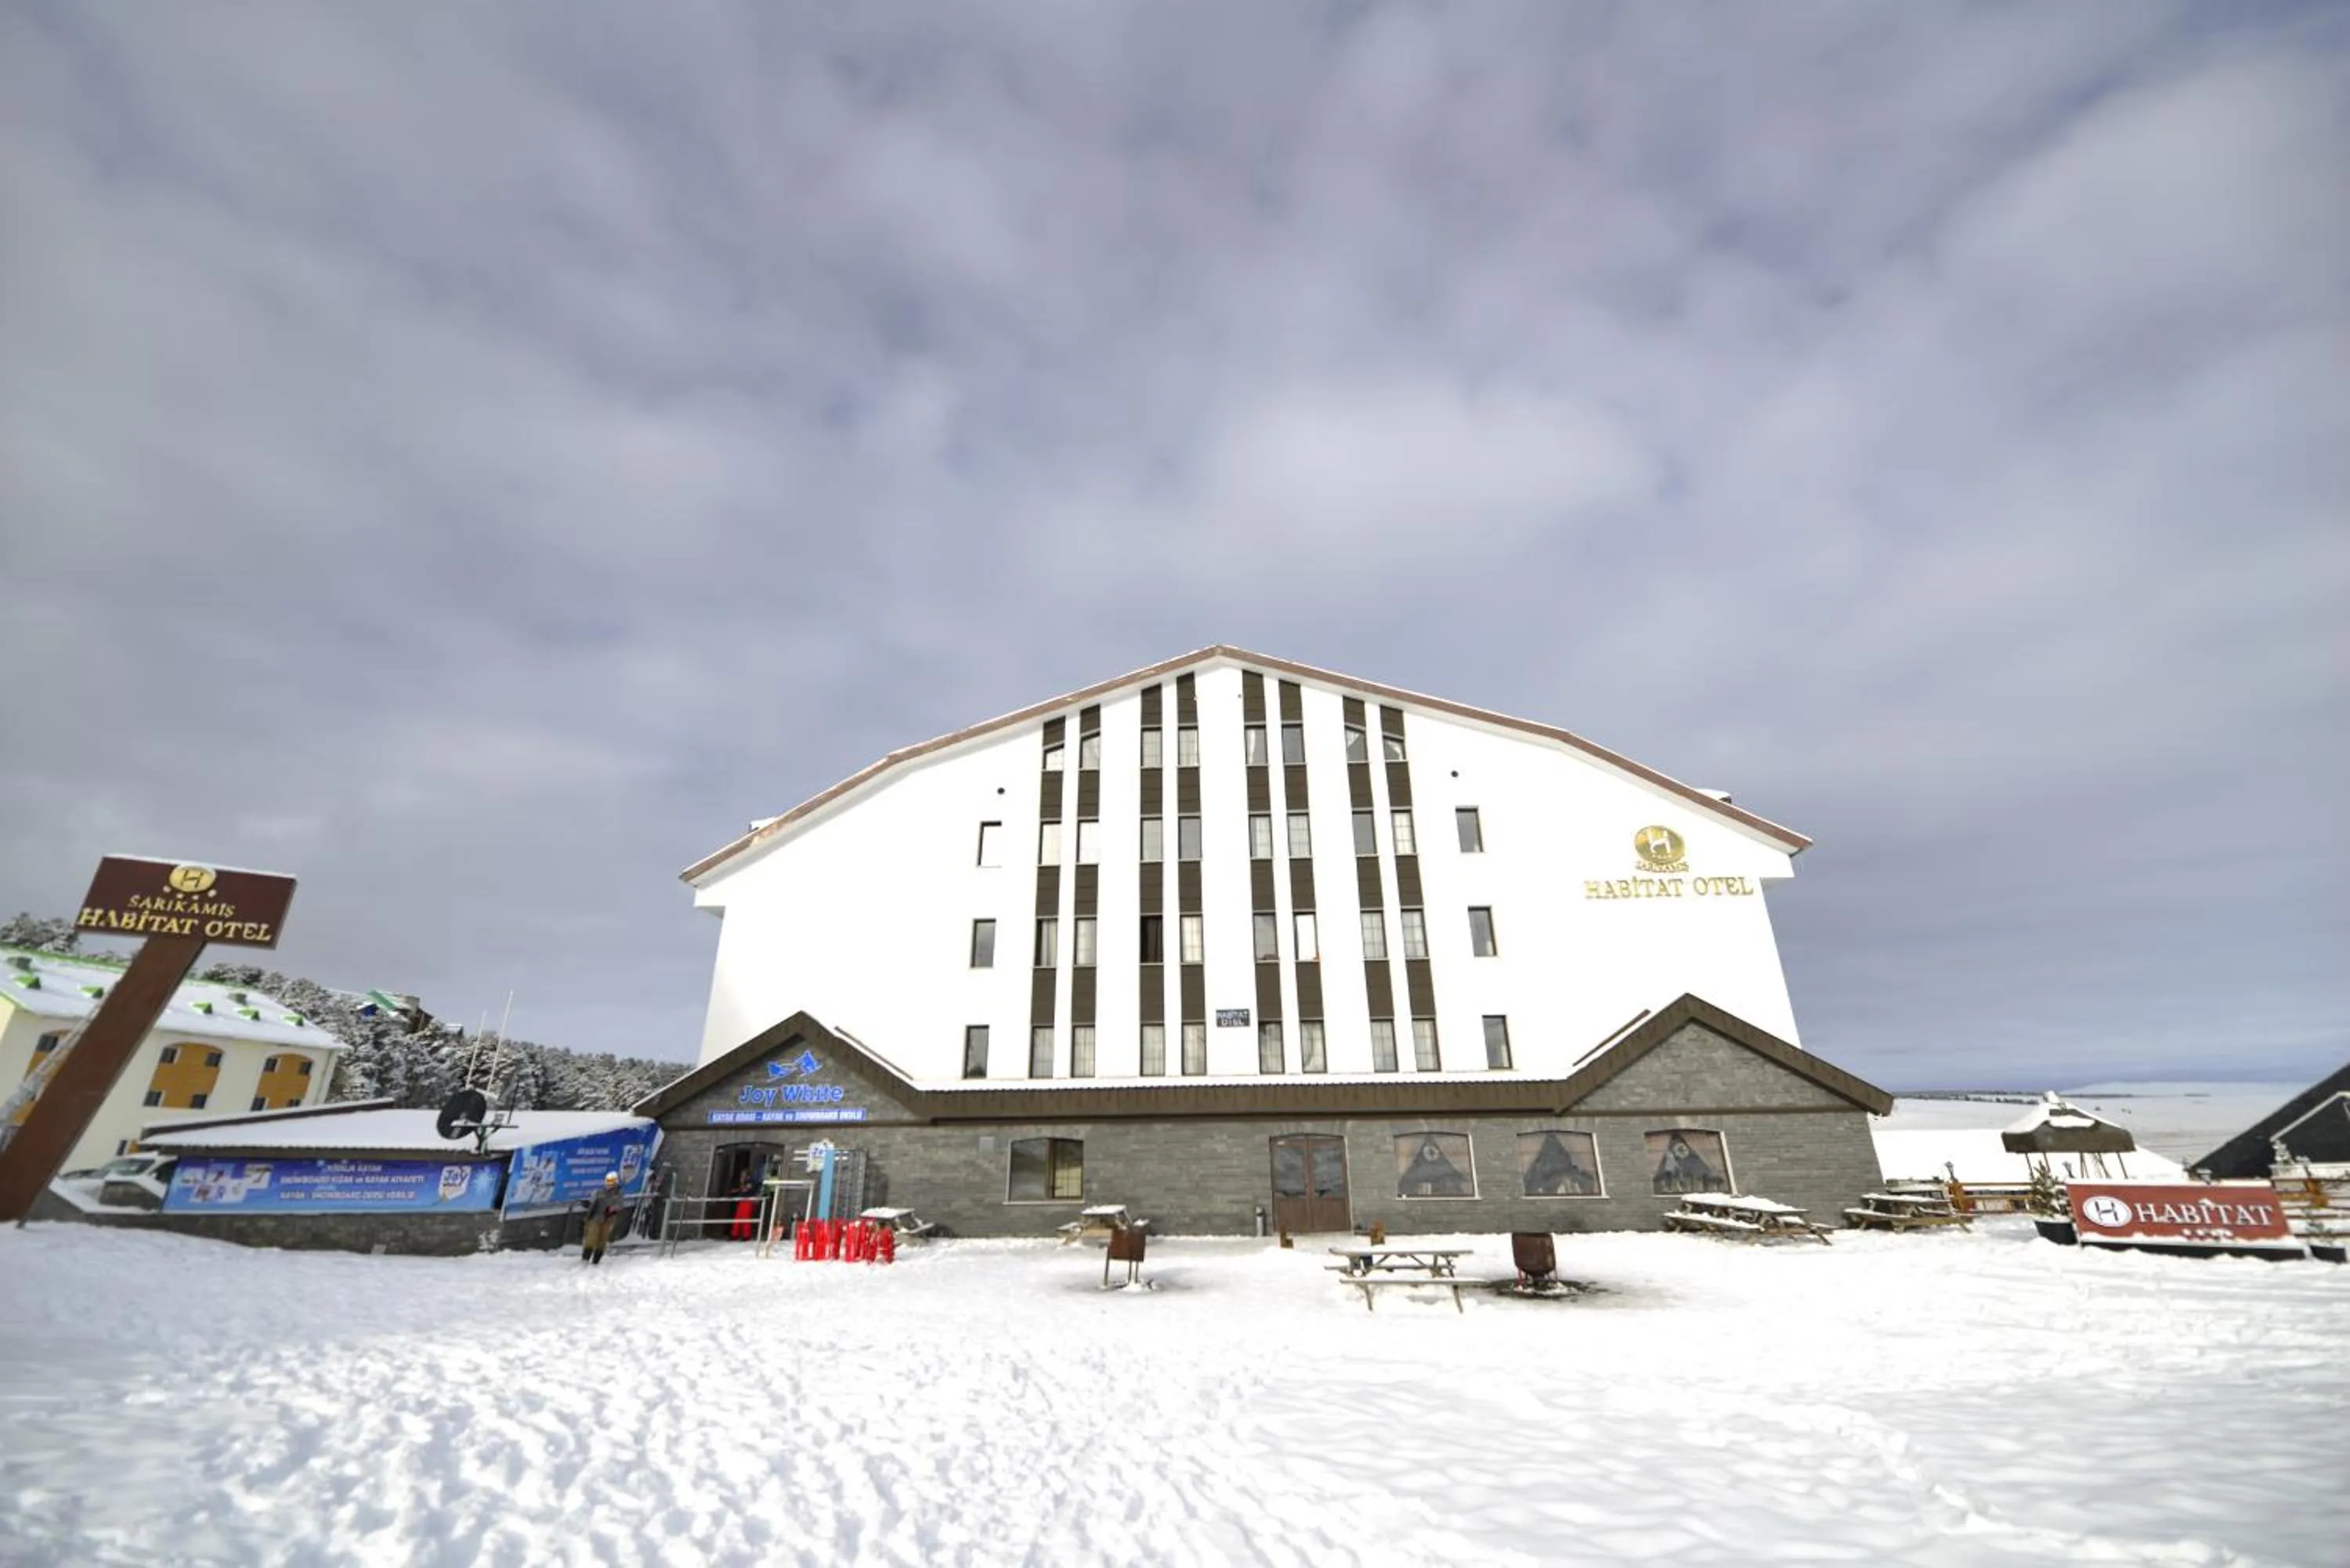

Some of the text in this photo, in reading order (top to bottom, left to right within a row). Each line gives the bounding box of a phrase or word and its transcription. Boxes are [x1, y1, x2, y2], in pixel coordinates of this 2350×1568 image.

[1584, 876, 1754, 898] HABİTAT OTEL
[78, 908, 273, 941] HABİTAT OTEL
[739, 1082, 844, 1107] Joy White
